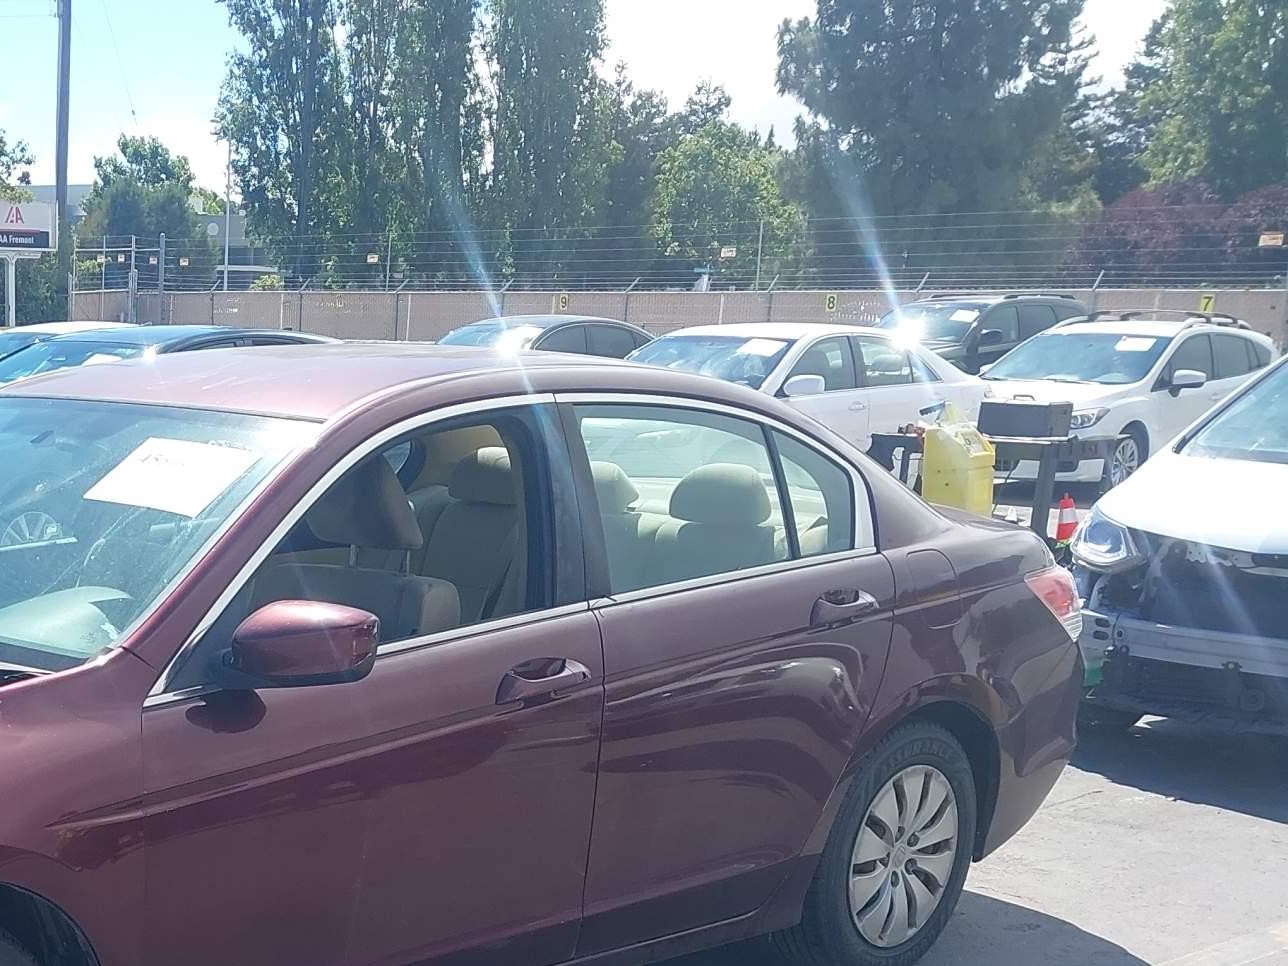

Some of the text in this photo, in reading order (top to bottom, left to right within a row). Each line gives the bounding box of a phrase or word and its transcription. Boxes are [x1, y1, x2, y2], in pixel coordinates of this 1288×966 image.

[9, 234, 34, 244] Fremont
[560, 296, 567, 309] 9
[827, 296, 835, 309] 8
[1202, 296, 1214, 312] 7
